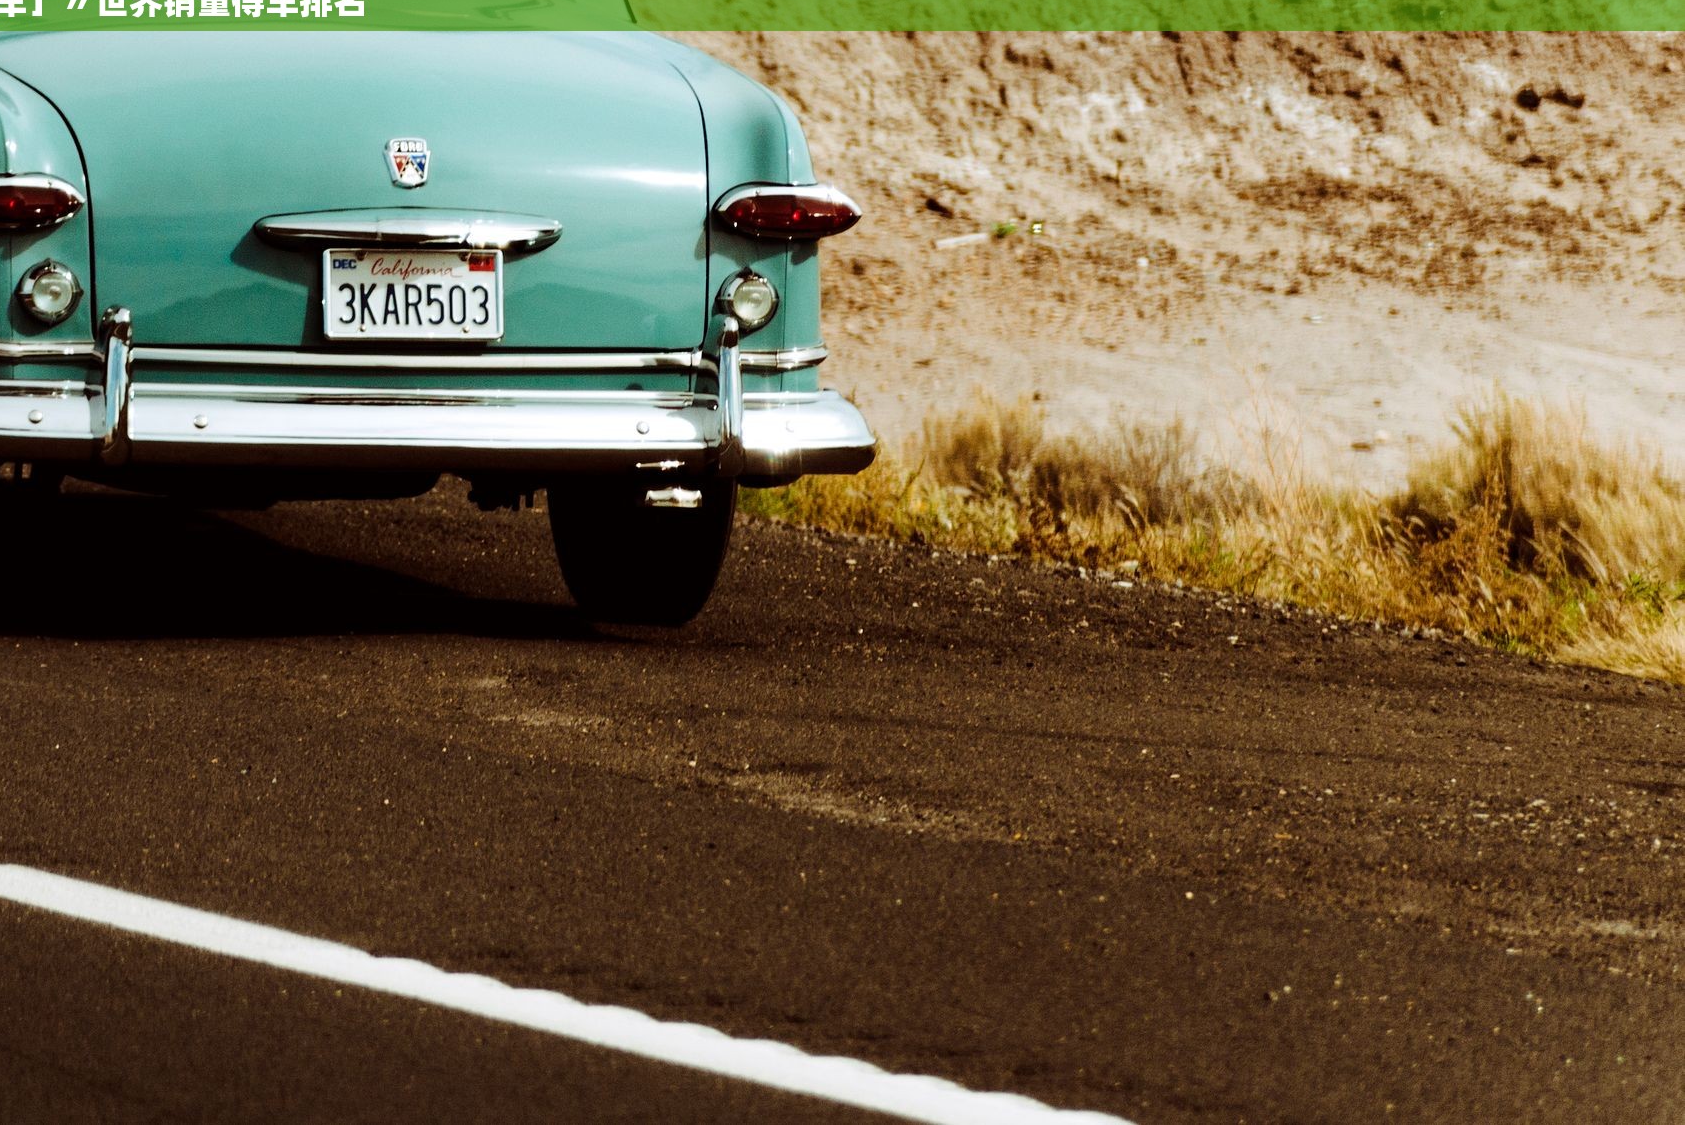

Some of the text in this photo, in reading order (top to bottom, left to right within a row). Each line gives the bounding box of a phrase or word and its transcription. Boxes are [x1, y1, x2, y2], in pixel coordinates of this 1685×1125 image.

[333, 259, 357, 269] DEC
[371, 258, 463, 280] California
[339, 283, 489, 325] 3KAR503
